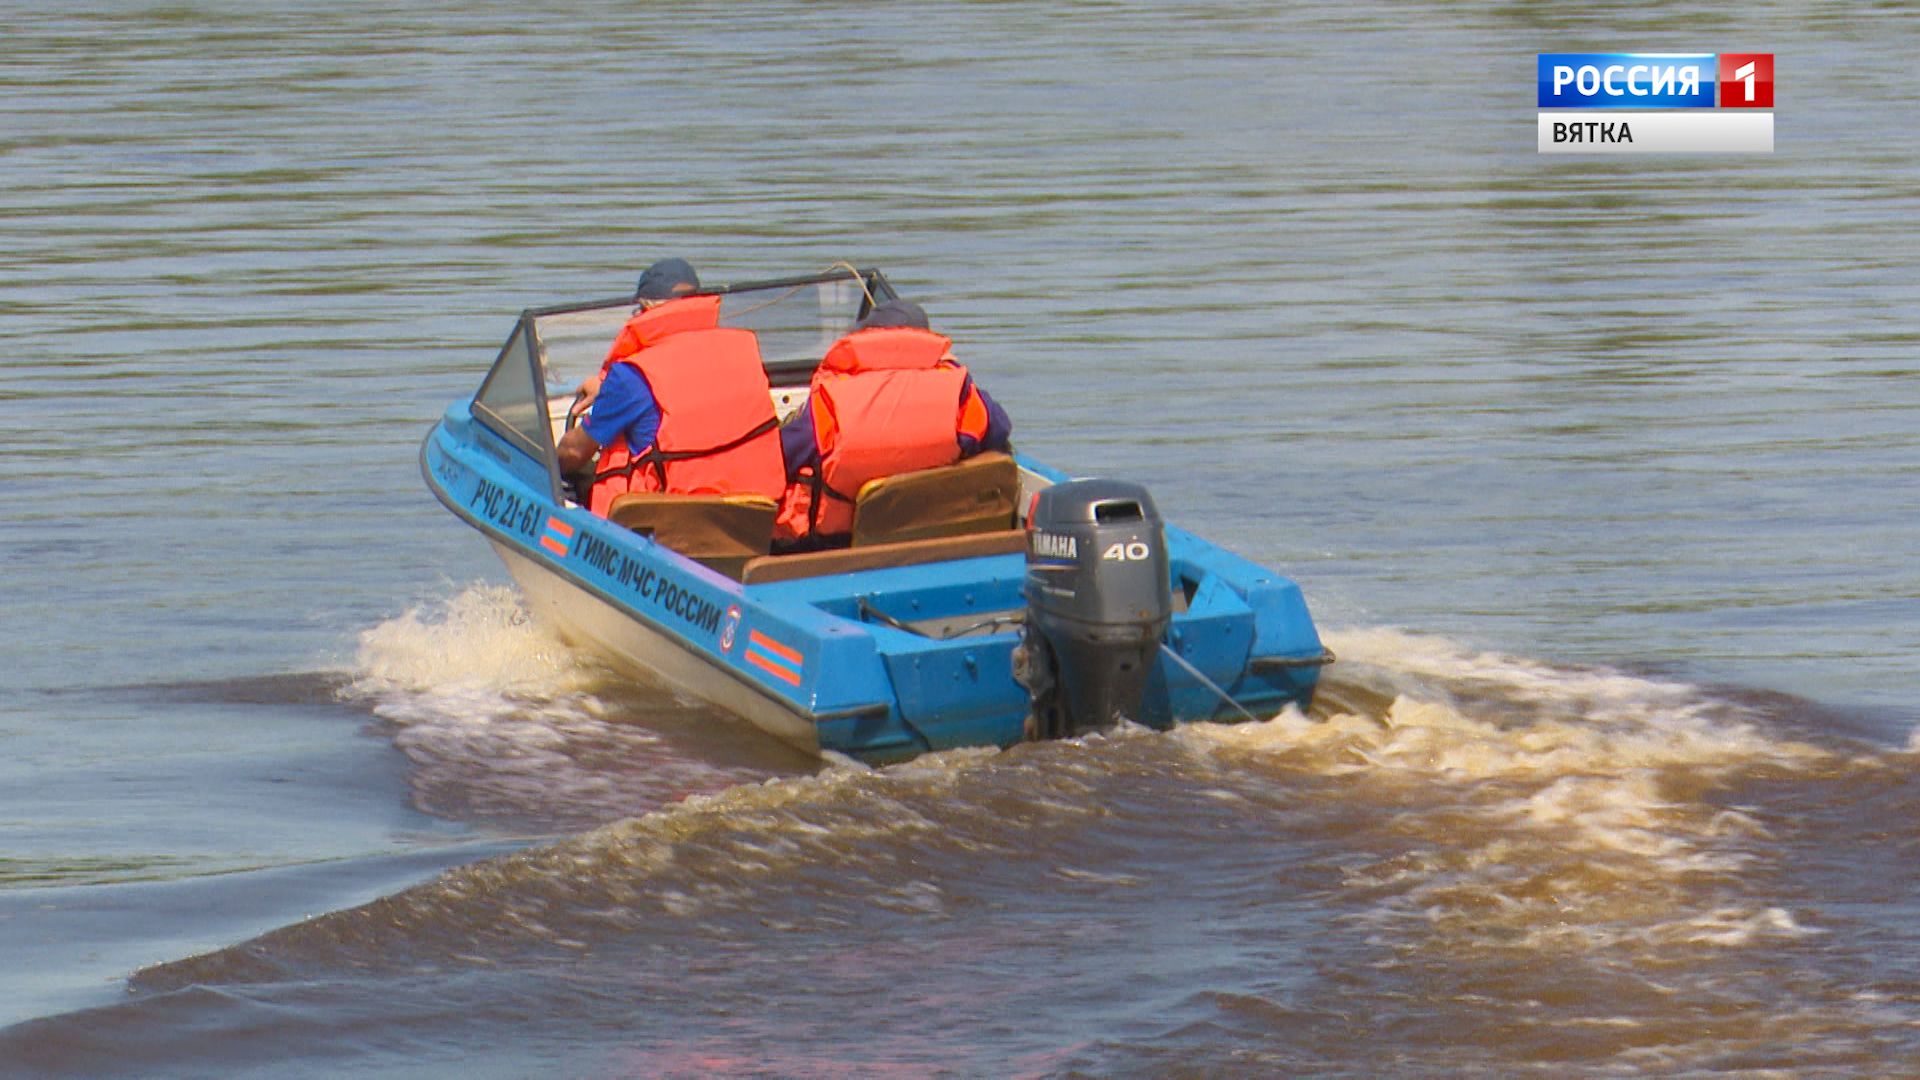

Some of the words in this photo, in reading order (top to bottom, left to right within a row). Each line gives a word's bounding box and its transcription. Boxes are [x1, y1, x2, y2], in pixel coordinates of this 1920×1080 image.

[470, 479, 504, 519] РЧС
[498, 494, 542, 537] 21-61
[1103, 542, 1149, 560] 40
[574, 530, 619, 576] ГИМС
[618, 556, 656, 598] МЧС
[654, 577, 722, 634] РОССИИ
